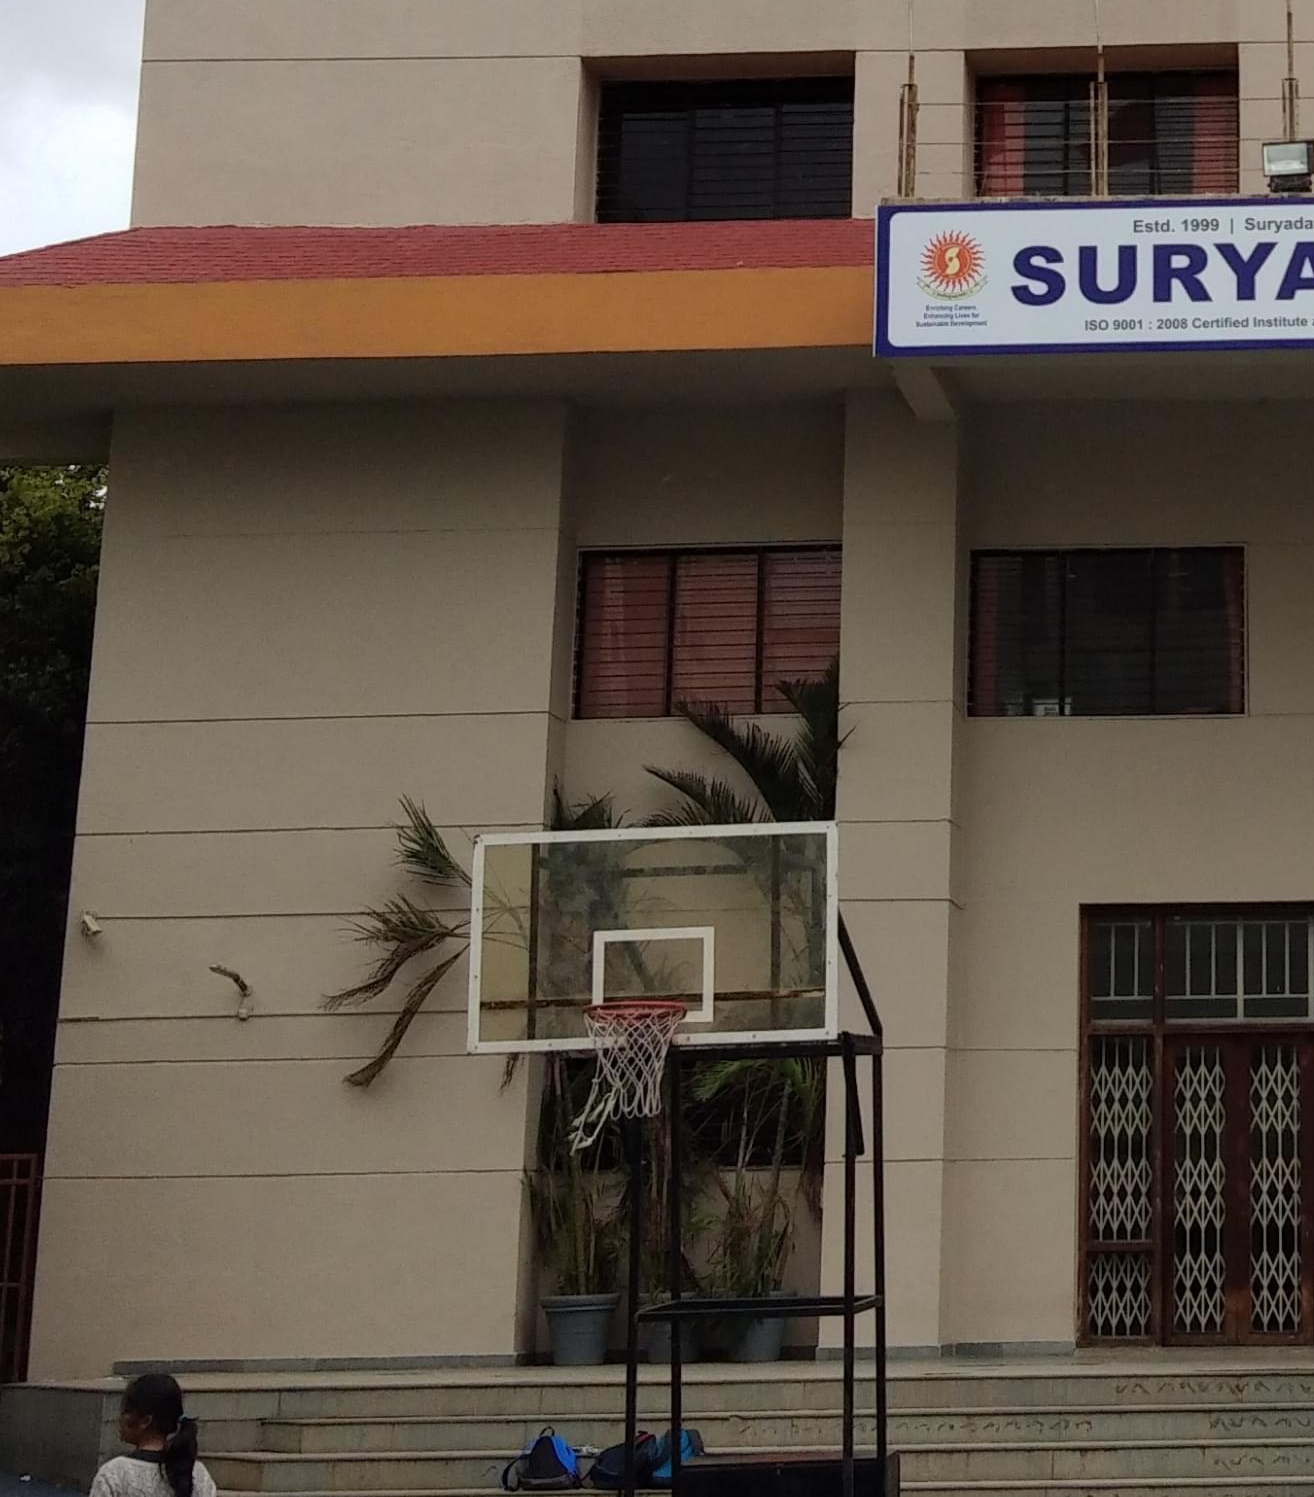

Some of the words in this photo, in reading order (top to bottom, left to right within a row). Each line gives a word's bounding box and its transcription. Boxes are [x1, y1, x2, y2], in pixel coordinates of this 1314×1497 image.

[1133, 219, 1175, 233] Estd.
[1181, 218, 1219, 232] 1999
[1085, 319, 1109, 331] ISO
[1113, 319, 1143, 330] 9001
[1156, 318, 1188, 329] 2008
[1192, 317, 1249, 329] Certified
[1253, 316, 1308, 328] Institute
